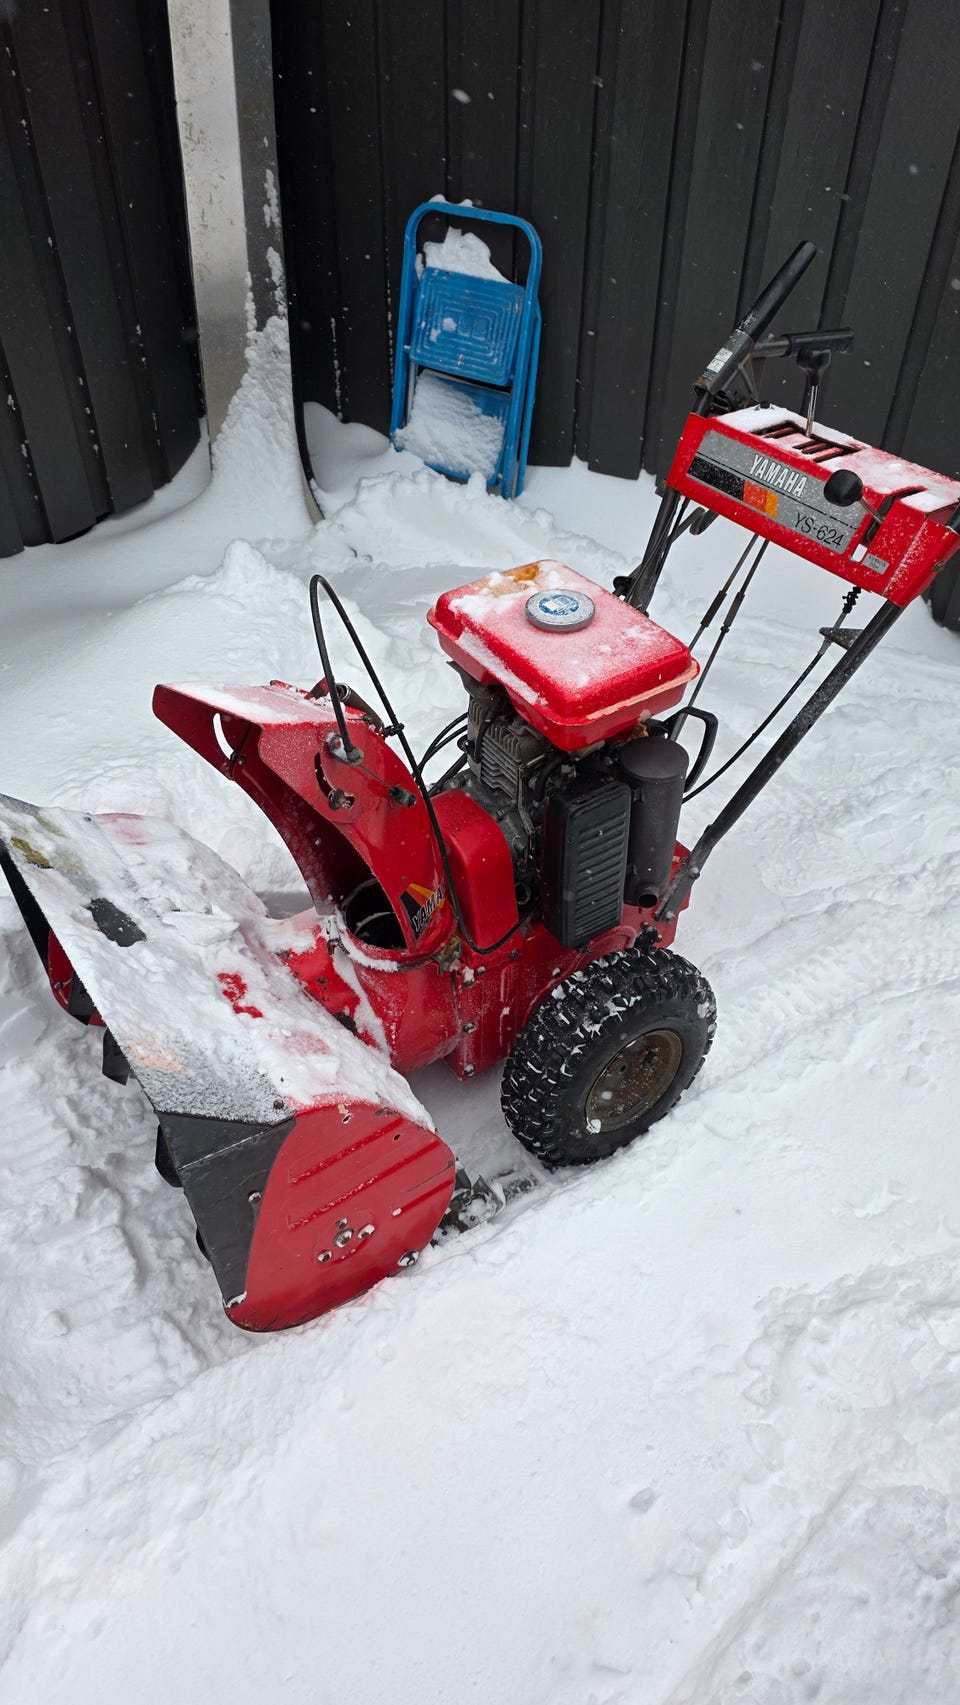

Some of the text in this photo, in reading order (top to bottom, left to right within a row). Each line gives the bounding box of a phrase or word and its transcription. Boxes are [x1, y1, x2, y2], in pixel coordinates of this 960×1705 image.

[749, 454, 808, 498] YAMAHA
[793, 511, 845, 548] YS-624
[412, 883, 445, 932] YAMA
